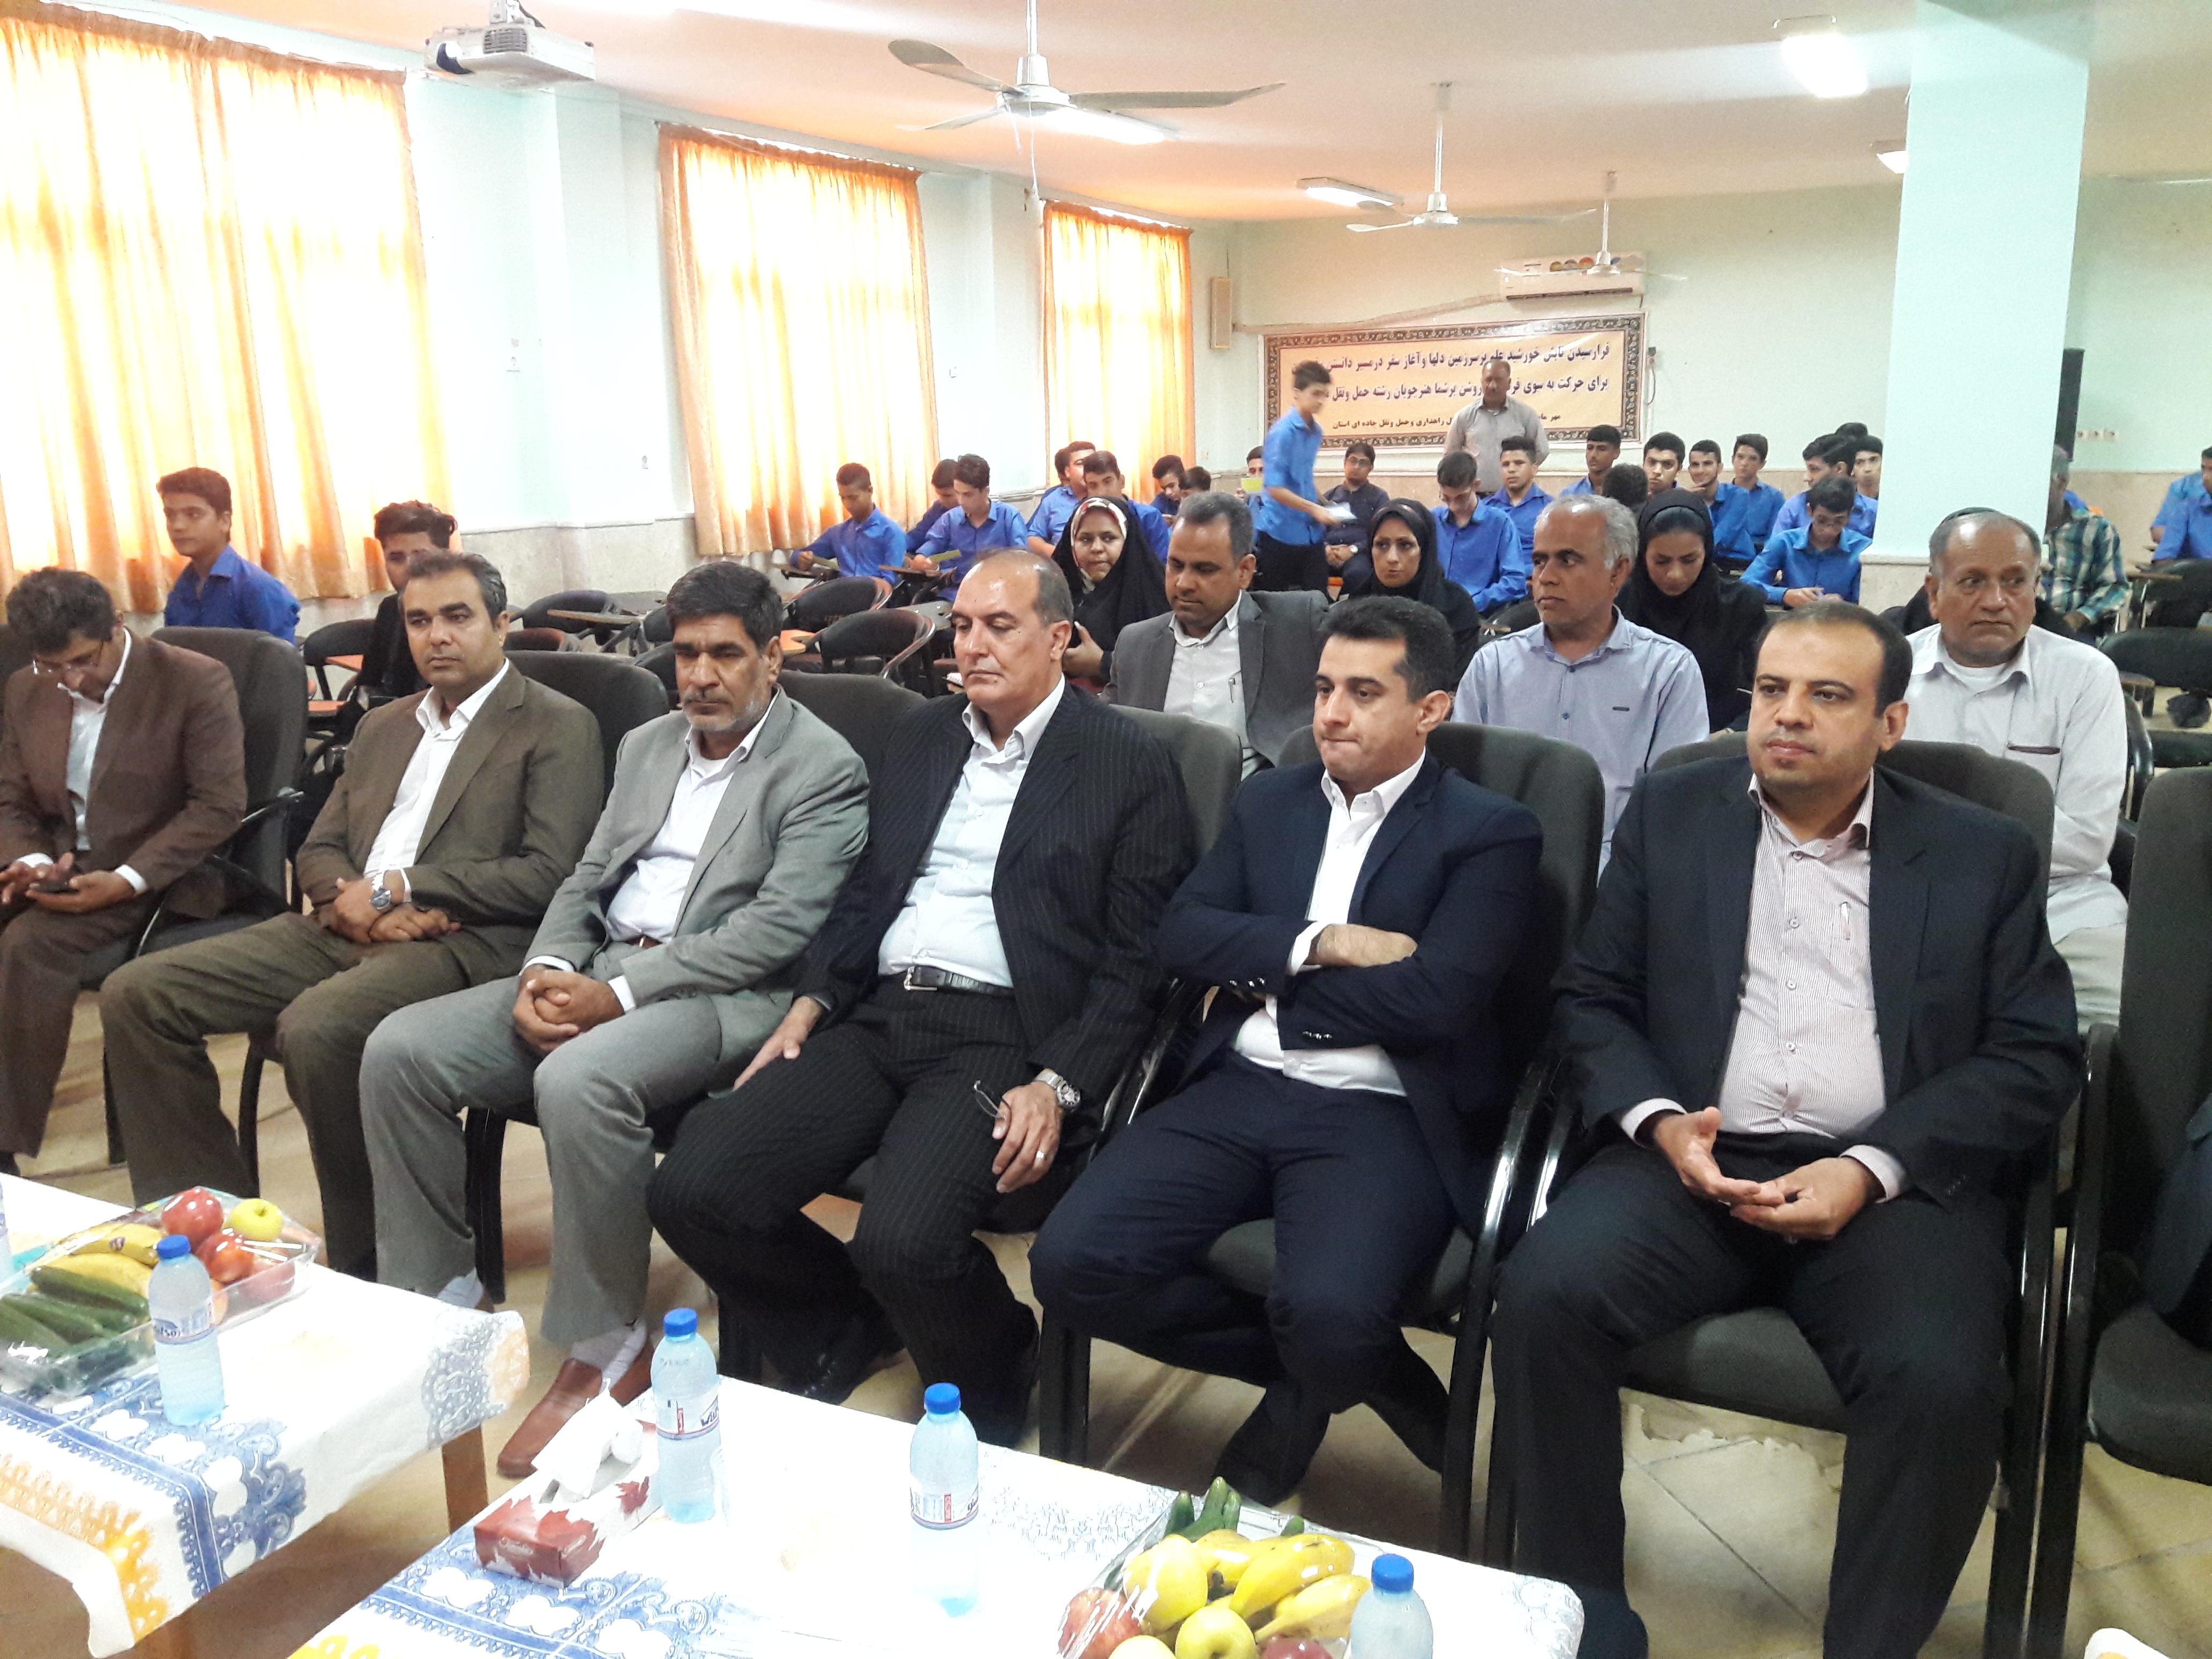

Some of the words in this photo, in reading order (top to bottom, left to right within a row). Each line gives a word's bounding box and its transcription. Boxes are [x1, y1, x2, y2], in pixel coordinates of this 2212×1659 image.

[1507, 346, 1540, 363] خورشید
[1546, 379, 1554, 392] به
[1557, 376, 1584, 393] حرکت
[1587, 375, 1608, 392] برای
[1352, 385, 1369, 400] حمل
